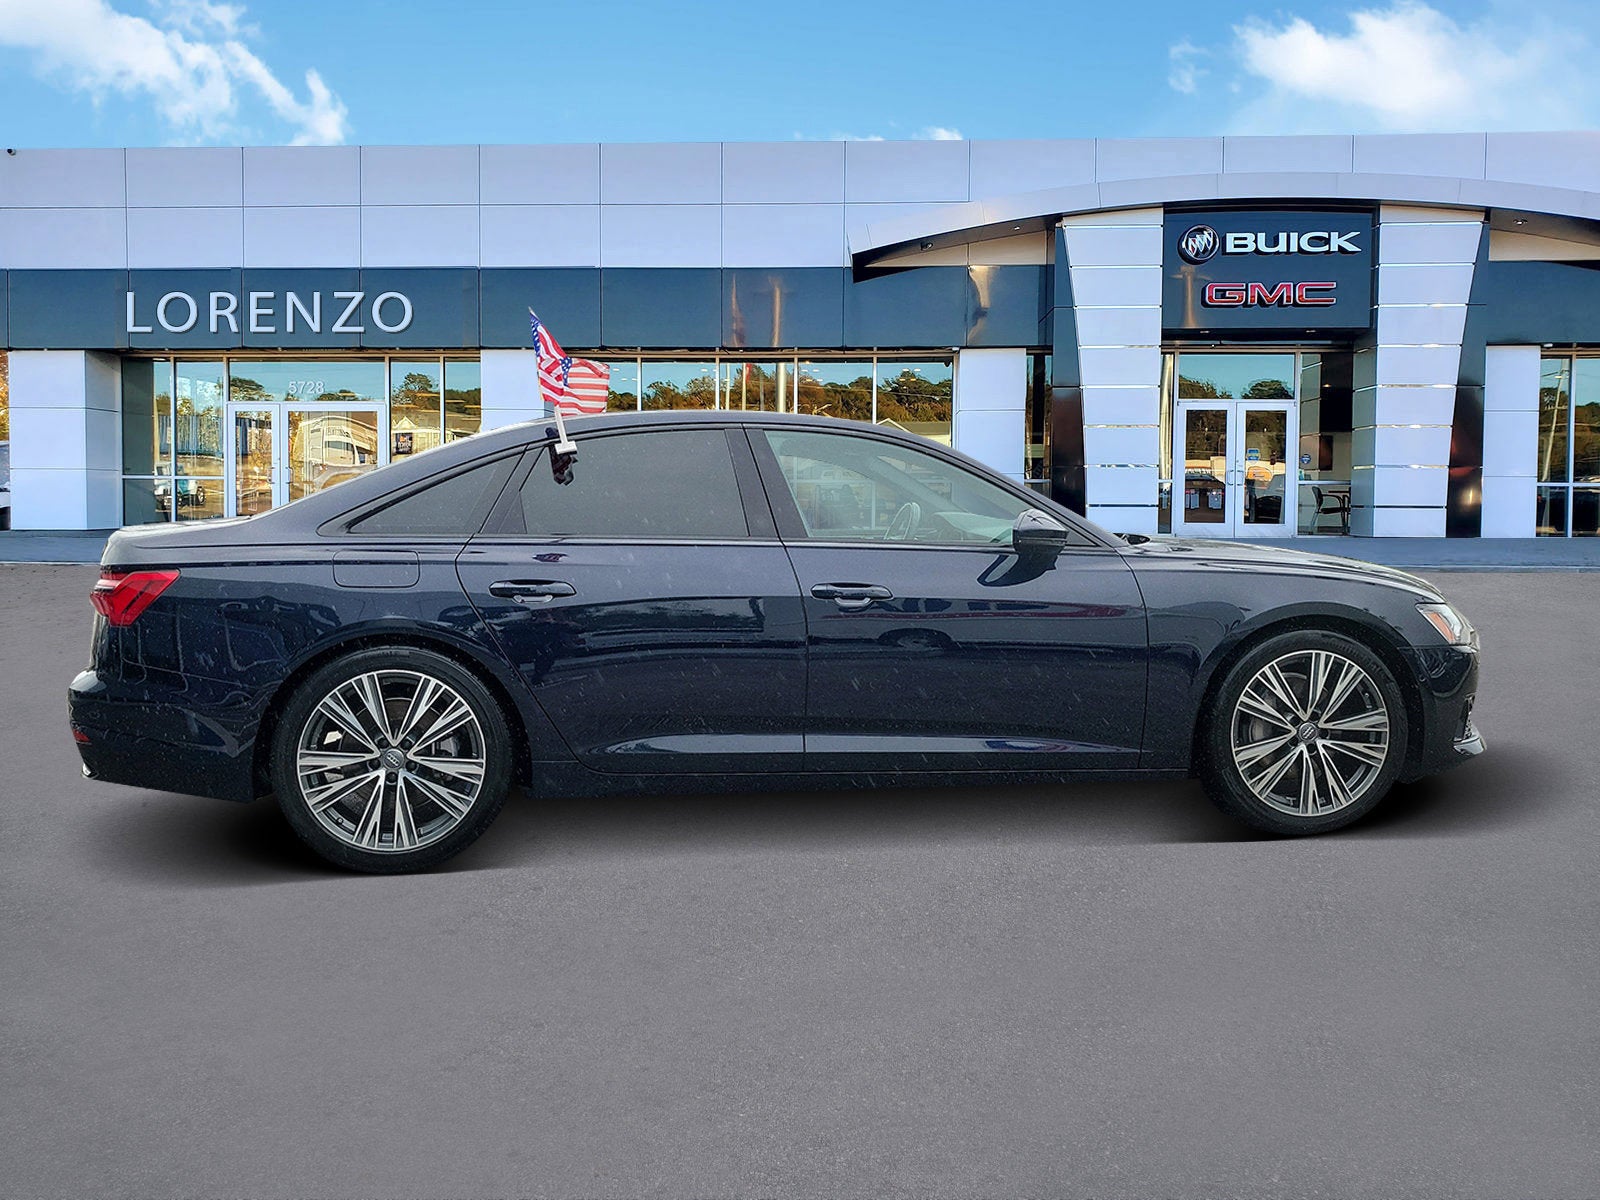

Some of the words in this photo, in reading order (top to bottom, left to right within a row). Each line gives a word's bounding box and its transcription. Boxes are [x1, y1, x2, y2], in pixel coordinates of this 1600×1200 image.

[1225, 231, 1362, 253] BUICK
[1205, 282, 1337, 305] GMC
[126, 291, 413, 333] LORENZO
[288, 380, 324, 394] 5728
